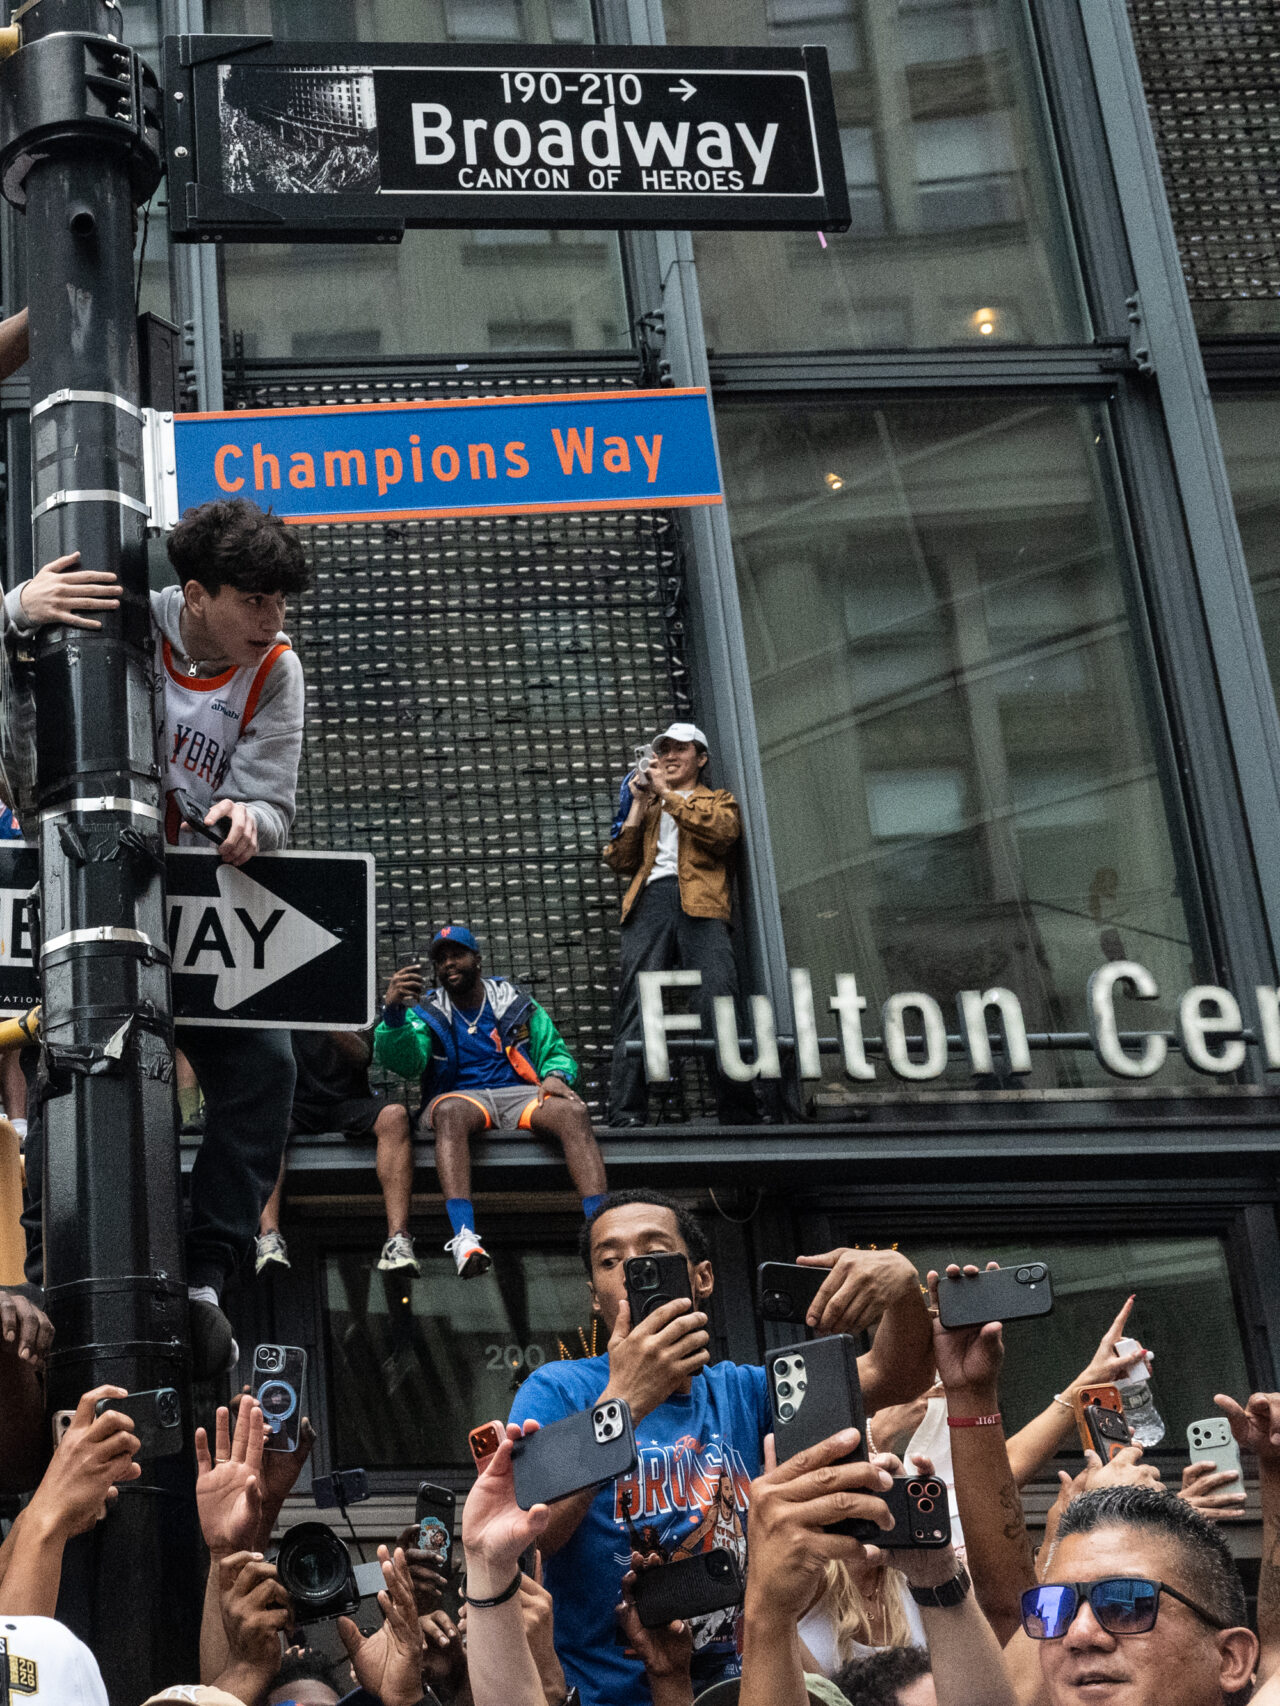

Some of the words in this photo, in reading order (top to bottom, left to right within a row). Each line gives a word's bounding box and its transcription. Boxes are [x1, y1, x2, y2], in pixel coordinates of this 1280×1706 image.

[500, 73, 642, 105] 190-210
[411, 102, 780, 187] Broadway
[457, 167, 570, 190] CANYON
[588, 167, 623, 190] OF
[641, 169, 745, 192] HEROES
[213, 434, 531, 497] Champions
[551, 427, 664, 484] Way
[637, 968, 1032, 1083] Fulton
[484, 1344, 546, 1370] 200
[18, 1659, 34, 1674] 20
[19, 1673, 34, 1687] 26
